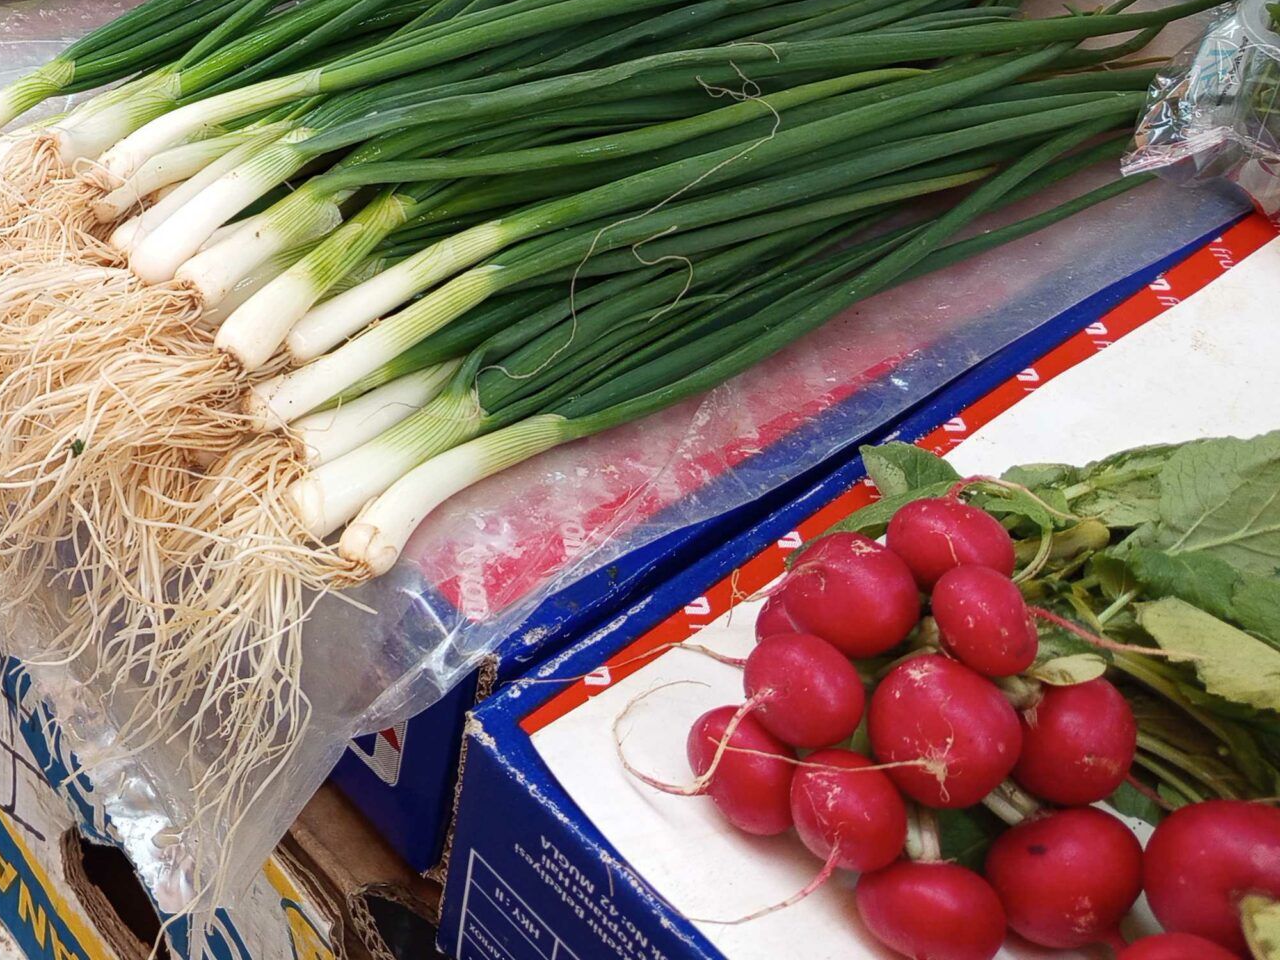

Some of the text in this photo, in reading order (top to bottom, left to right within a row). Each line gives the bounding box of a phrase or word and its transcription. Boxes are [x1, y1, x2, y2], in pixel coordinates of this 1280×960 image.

[514, 842, 585, 920] Belediyesi
[600, 894, 619, 916] 42
[512, 907, 540, 940] HKY
